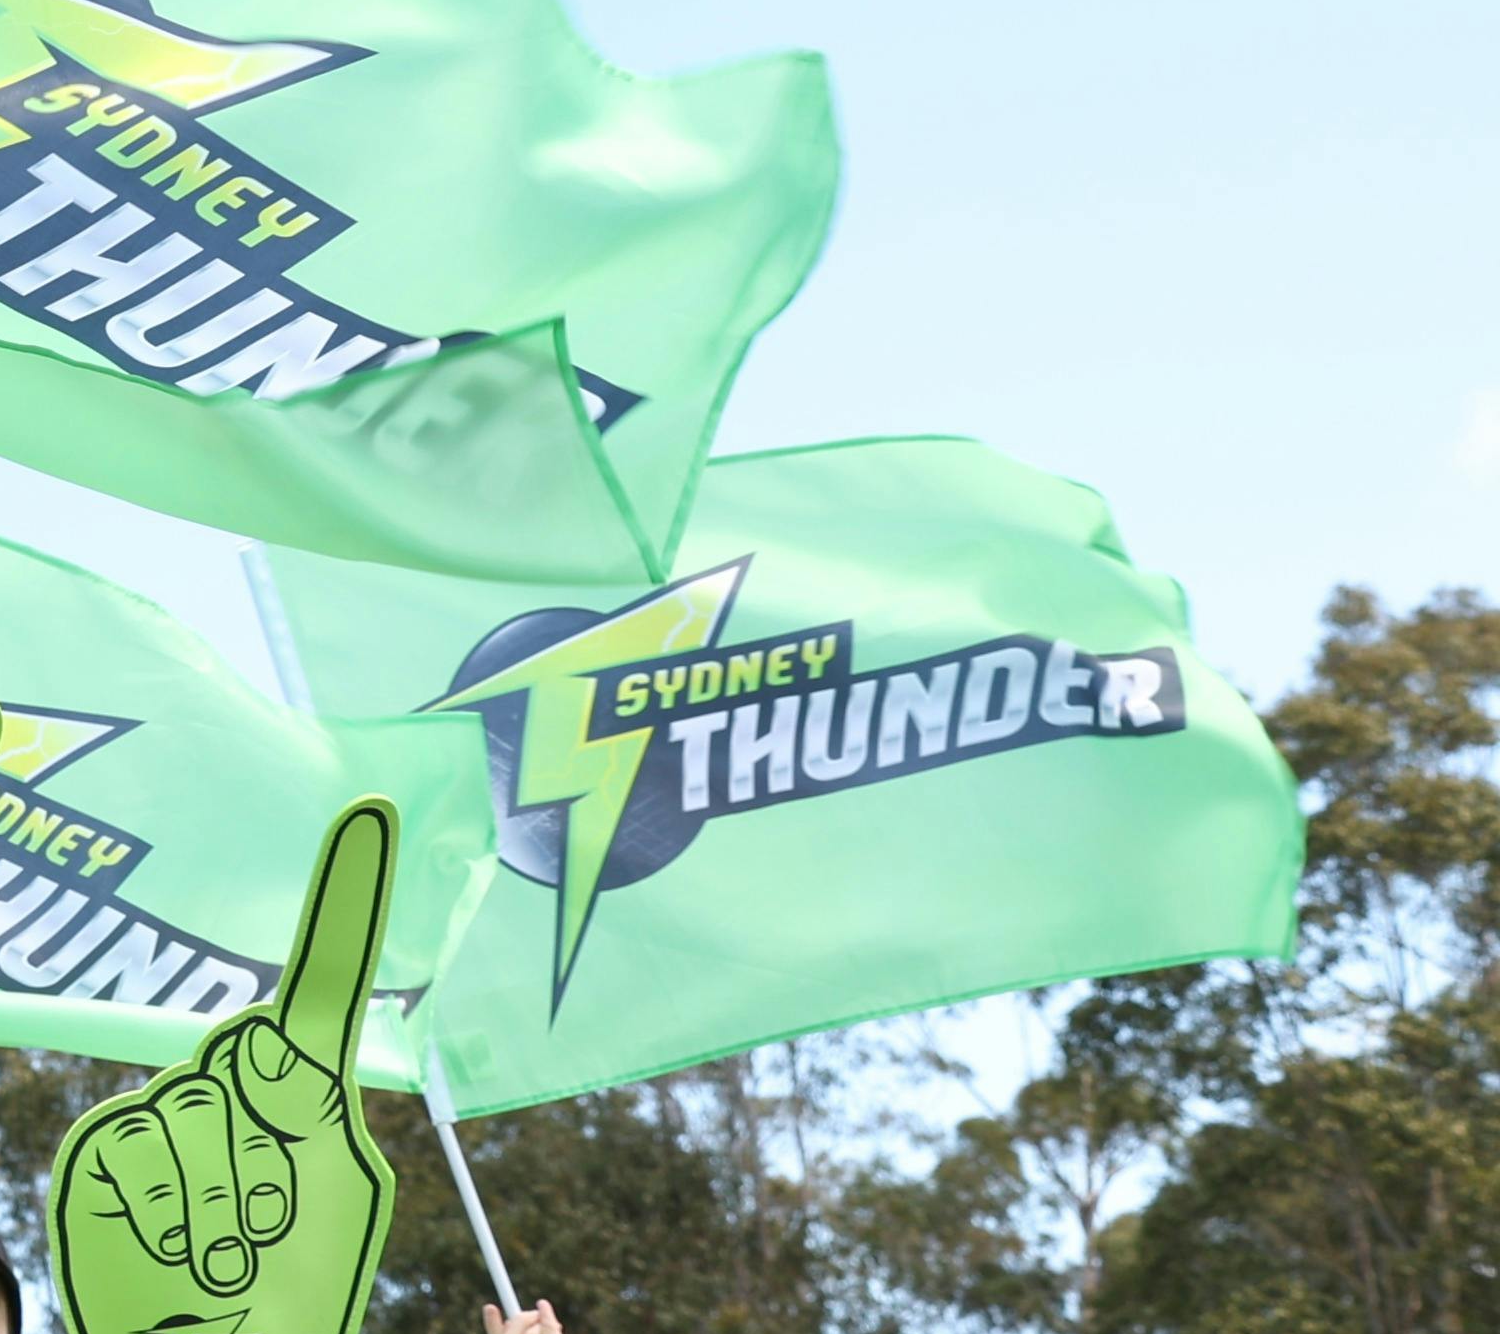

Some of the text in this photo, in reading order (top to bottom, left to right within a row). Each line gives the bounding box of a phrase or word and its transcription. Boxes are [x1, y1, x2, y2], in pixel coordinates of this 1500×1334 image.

[22, 81, 321, 249] SYDNEY
[615, 634, 838, 719] SYDNEY
[667, 640, 1164, 813] THUNDER
